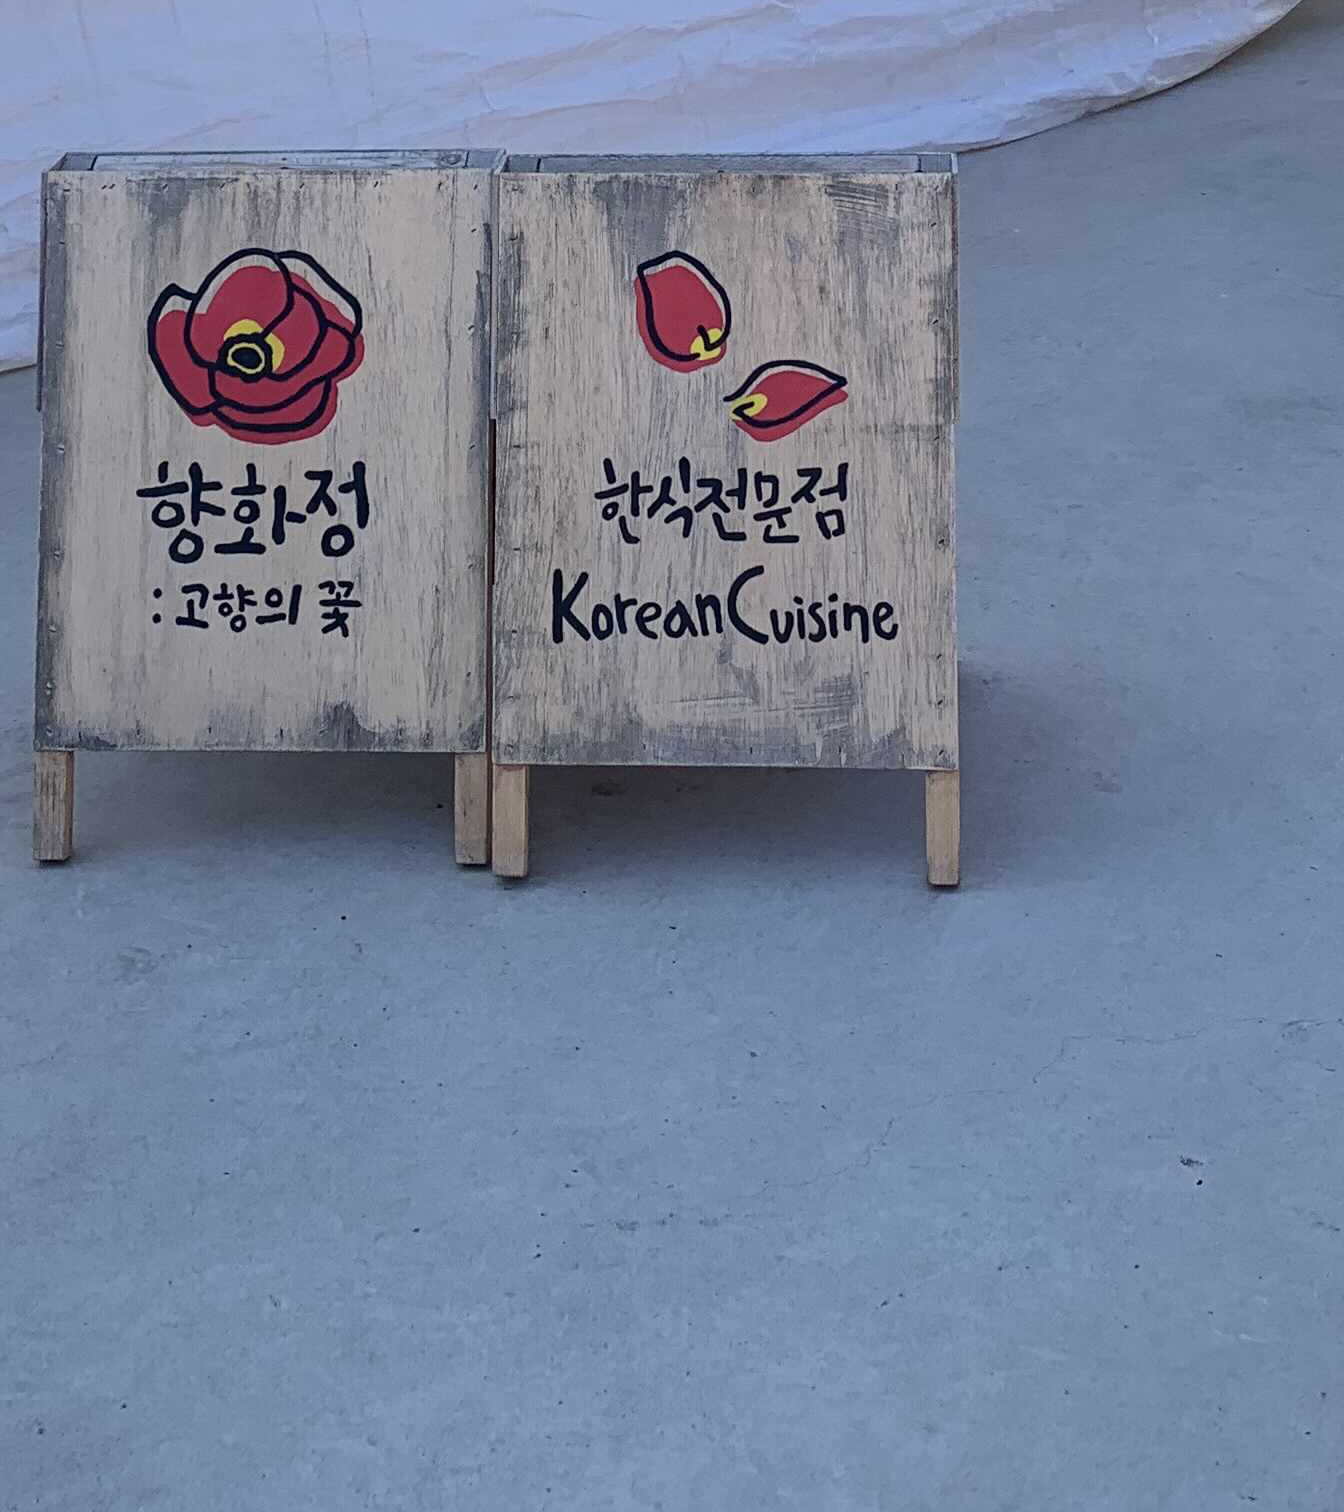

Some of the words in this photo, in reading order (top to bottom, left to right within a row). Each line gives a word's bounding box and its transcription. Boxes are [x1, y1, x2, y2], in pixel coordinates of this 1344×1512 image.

[135, 460, 371, 565] 향화정
[593, 456, 849, 545] 한식전문점
[317, 580, 364, 639] 꽃
